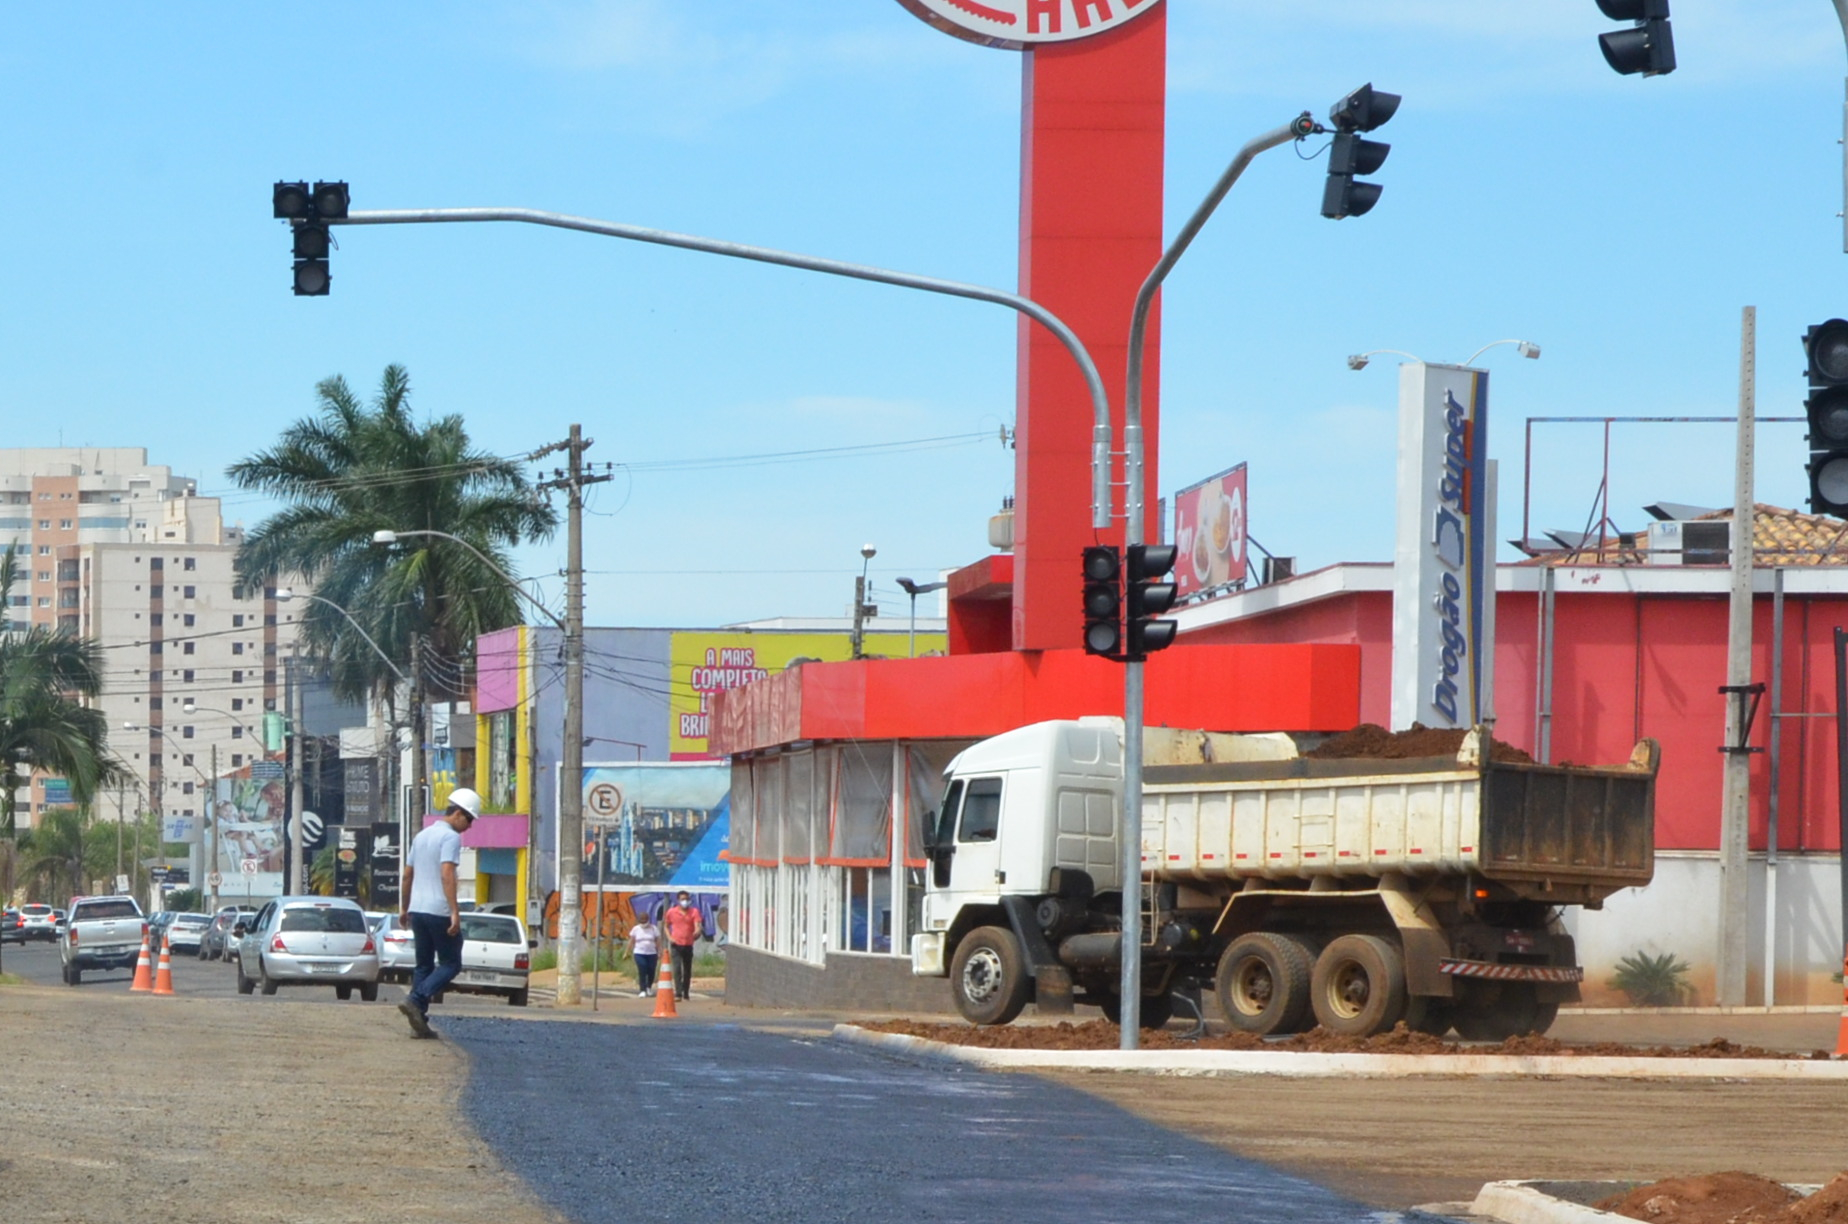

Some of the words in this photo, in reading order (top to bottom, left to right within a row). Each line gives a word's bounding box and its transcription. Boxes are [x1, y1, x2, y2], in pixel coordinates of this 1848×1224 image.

[1439, 388, 1471, 511] Super
[706, 649, 715, 666] A
[721, 649, 753, 666] MAIS
[1430, 571, 1466, 724] Drogão
